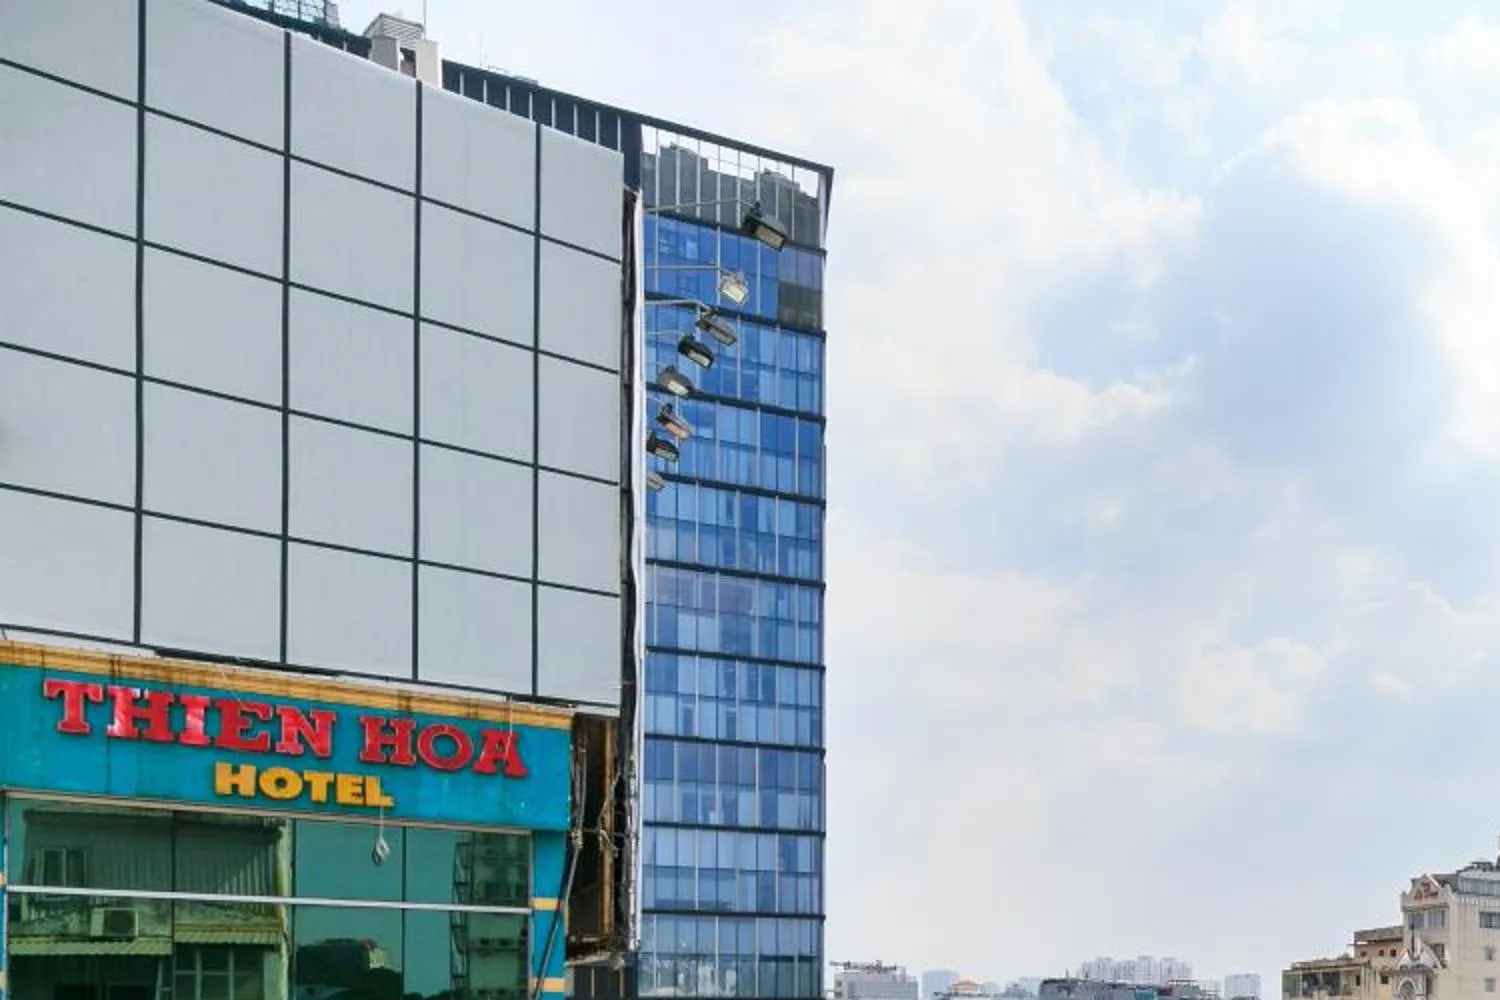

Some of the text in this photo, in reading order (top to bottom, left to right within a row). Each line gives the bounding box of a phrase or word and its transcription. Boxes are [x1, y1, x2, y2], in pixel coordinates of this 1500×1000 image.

[43, 677, 529, 778] THIEN HOA
[214, 761, 394, 808] HOTEL
